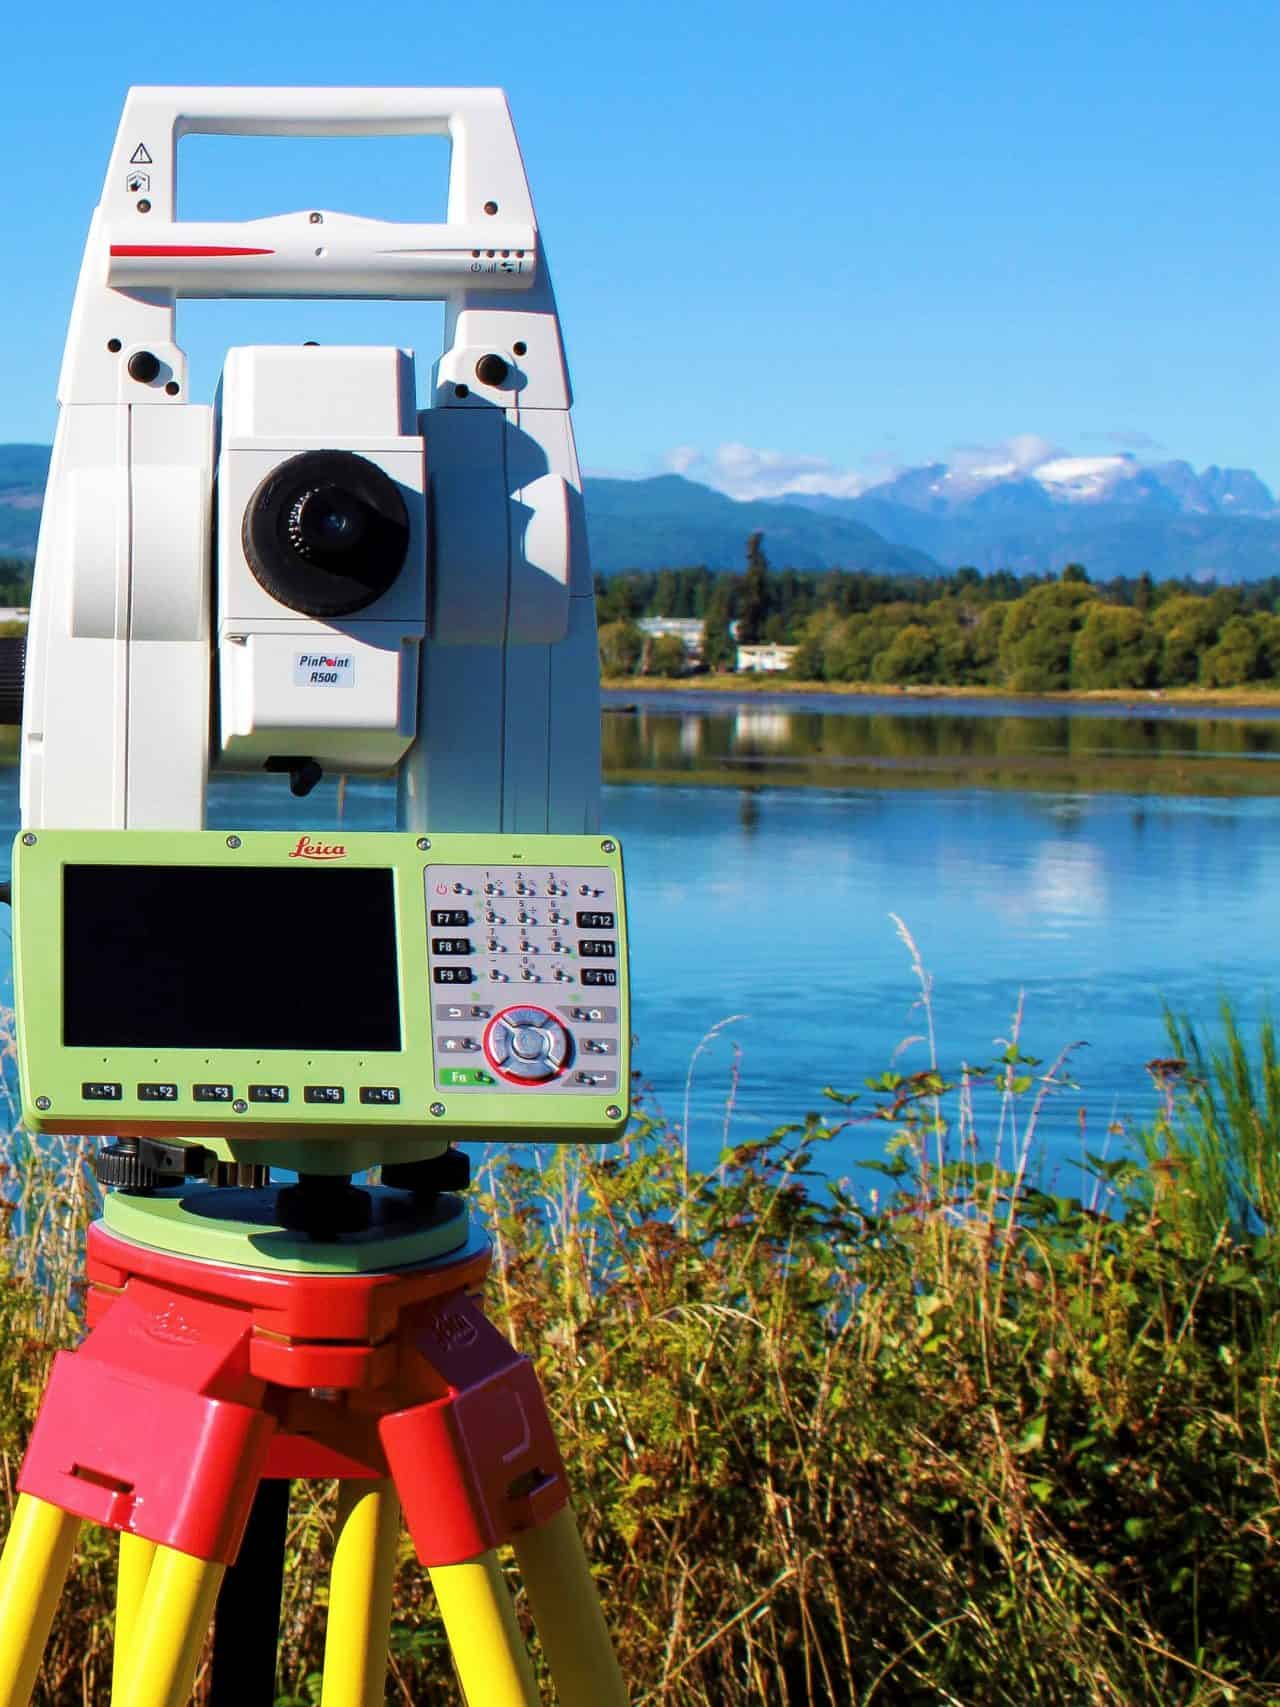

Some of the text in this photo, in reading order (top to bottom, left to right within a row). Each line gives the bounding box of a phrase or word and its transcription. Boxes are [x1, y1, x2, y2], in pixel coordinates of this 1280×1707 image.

[310, 671, 338, 683] R500
[288, 835, 347, 860] Leica
[437, 913, 450, 924] F7
[592, 915, 613, 926] F12
[594, 943, 613, 955] F11
[440, 970, 454, 981] F9
[596, 972, 615, 984] F10
